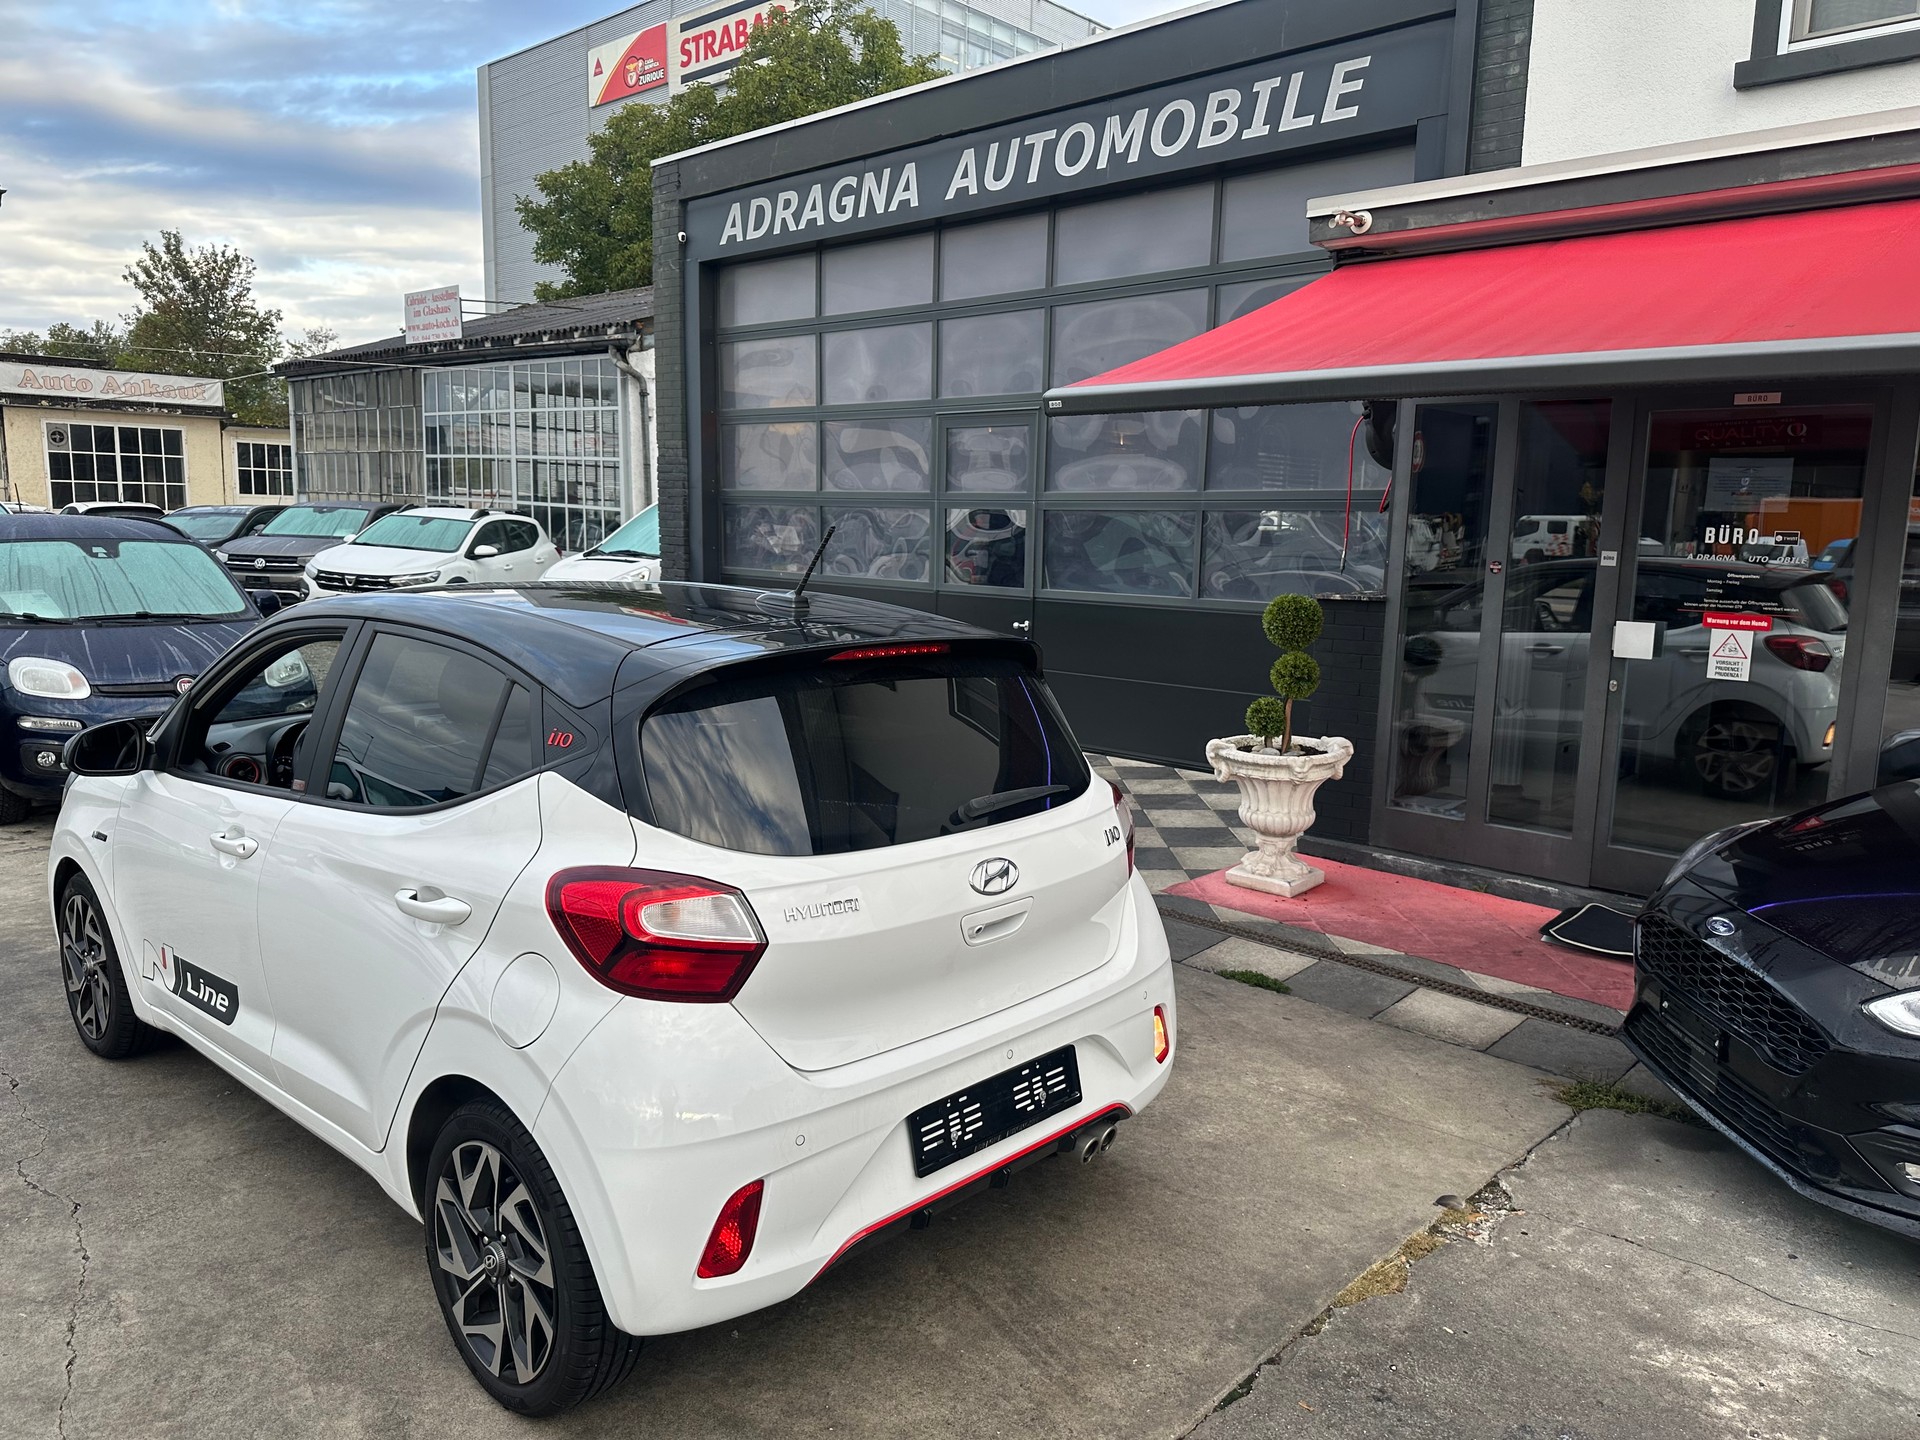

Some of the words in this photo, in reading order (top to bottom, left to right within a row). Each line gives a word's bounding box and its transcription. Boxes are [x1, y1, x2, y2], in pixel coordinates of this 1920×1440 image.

[638, 68, 665, 86] ZURIQUE
[719, 161, 920, 246] ADRAGNA
[944, 54, 1372, 201] AUTOMOBILE
[17, 368, 94, 393] Auto
[100, 375, 207, 401] Ankauf
[1695, 423, 1785, 441] QUALITY
[1704, 524, 1759, 545] BÜRO
[1707, 617, 1729, 625] Warnung
[547, 727, 574, 749] i10
[783, 897, 861, 923] HYUNDAI
[186, 971, 229, 1013] Line
